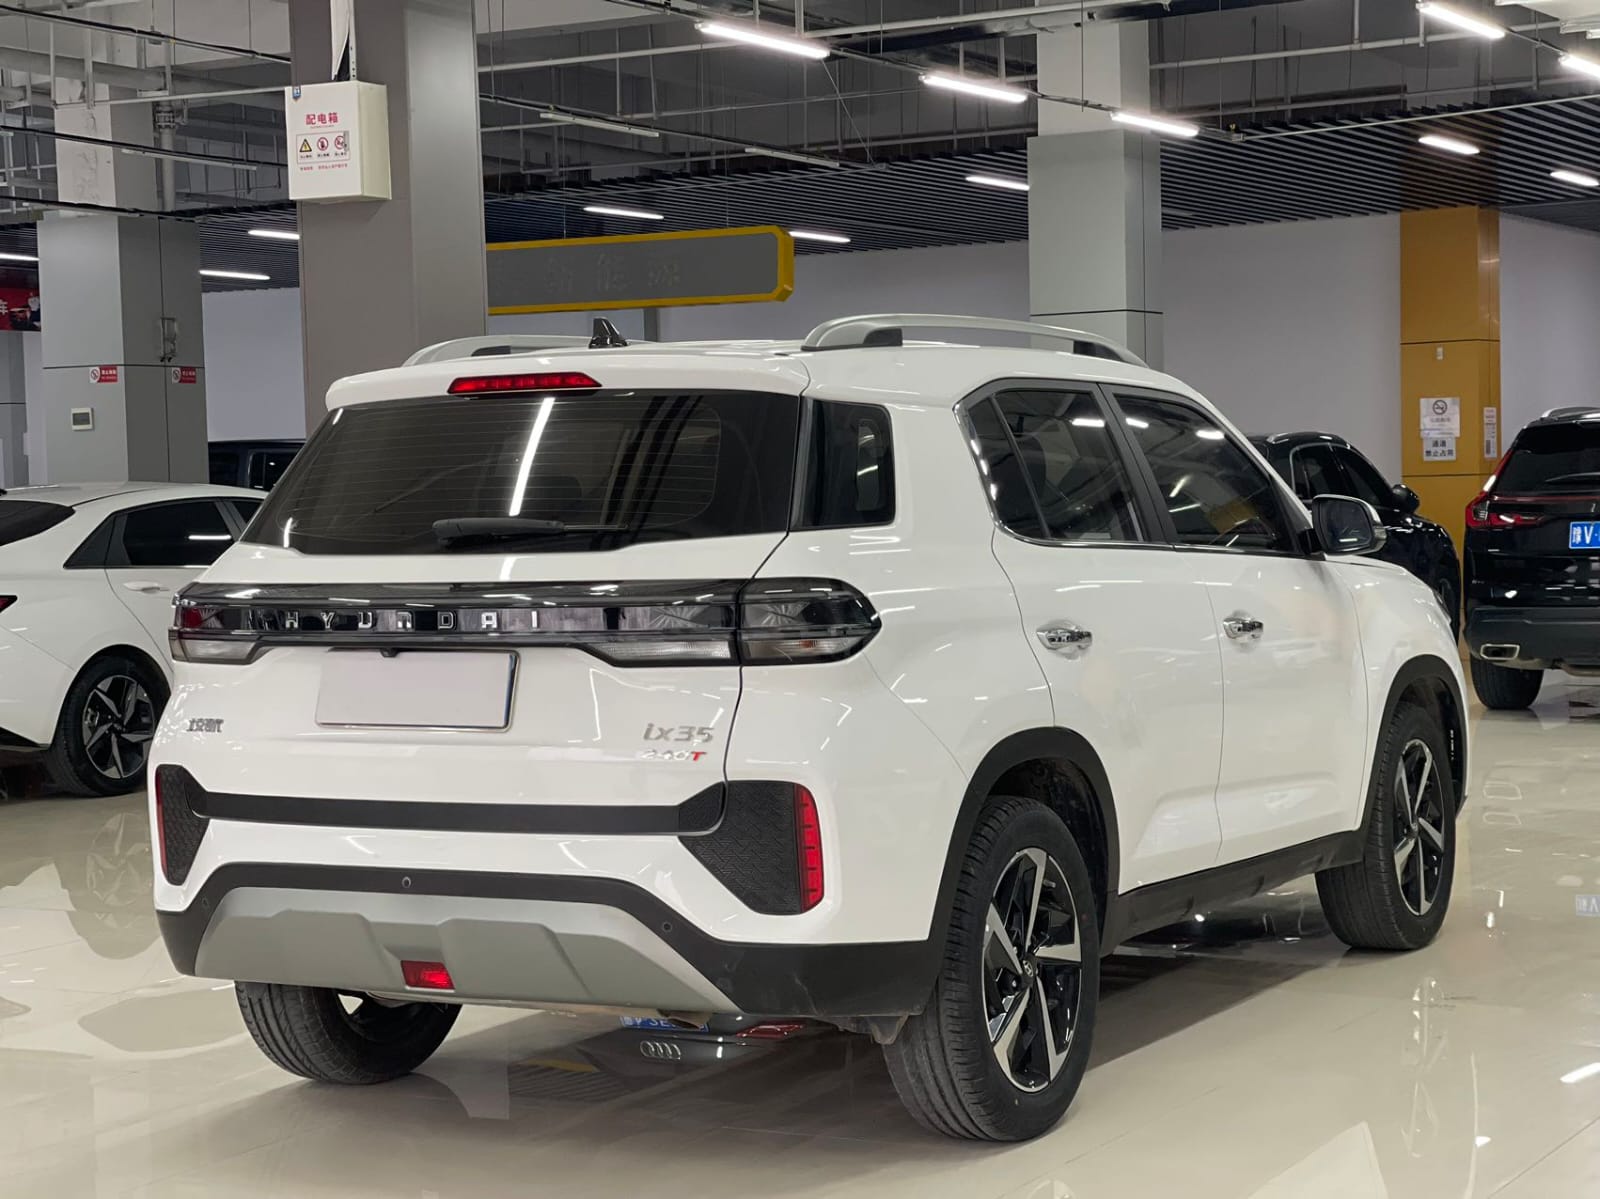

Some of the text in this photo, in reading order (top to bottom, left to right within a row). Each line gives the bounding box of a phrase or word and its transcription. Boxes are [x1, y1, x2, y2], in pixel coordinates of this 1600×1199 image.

[306, 112, 338, 125] 配电箱
[285, 611, 538, 630] HYUNDAI
[643, 723, 715, 742] ix35
